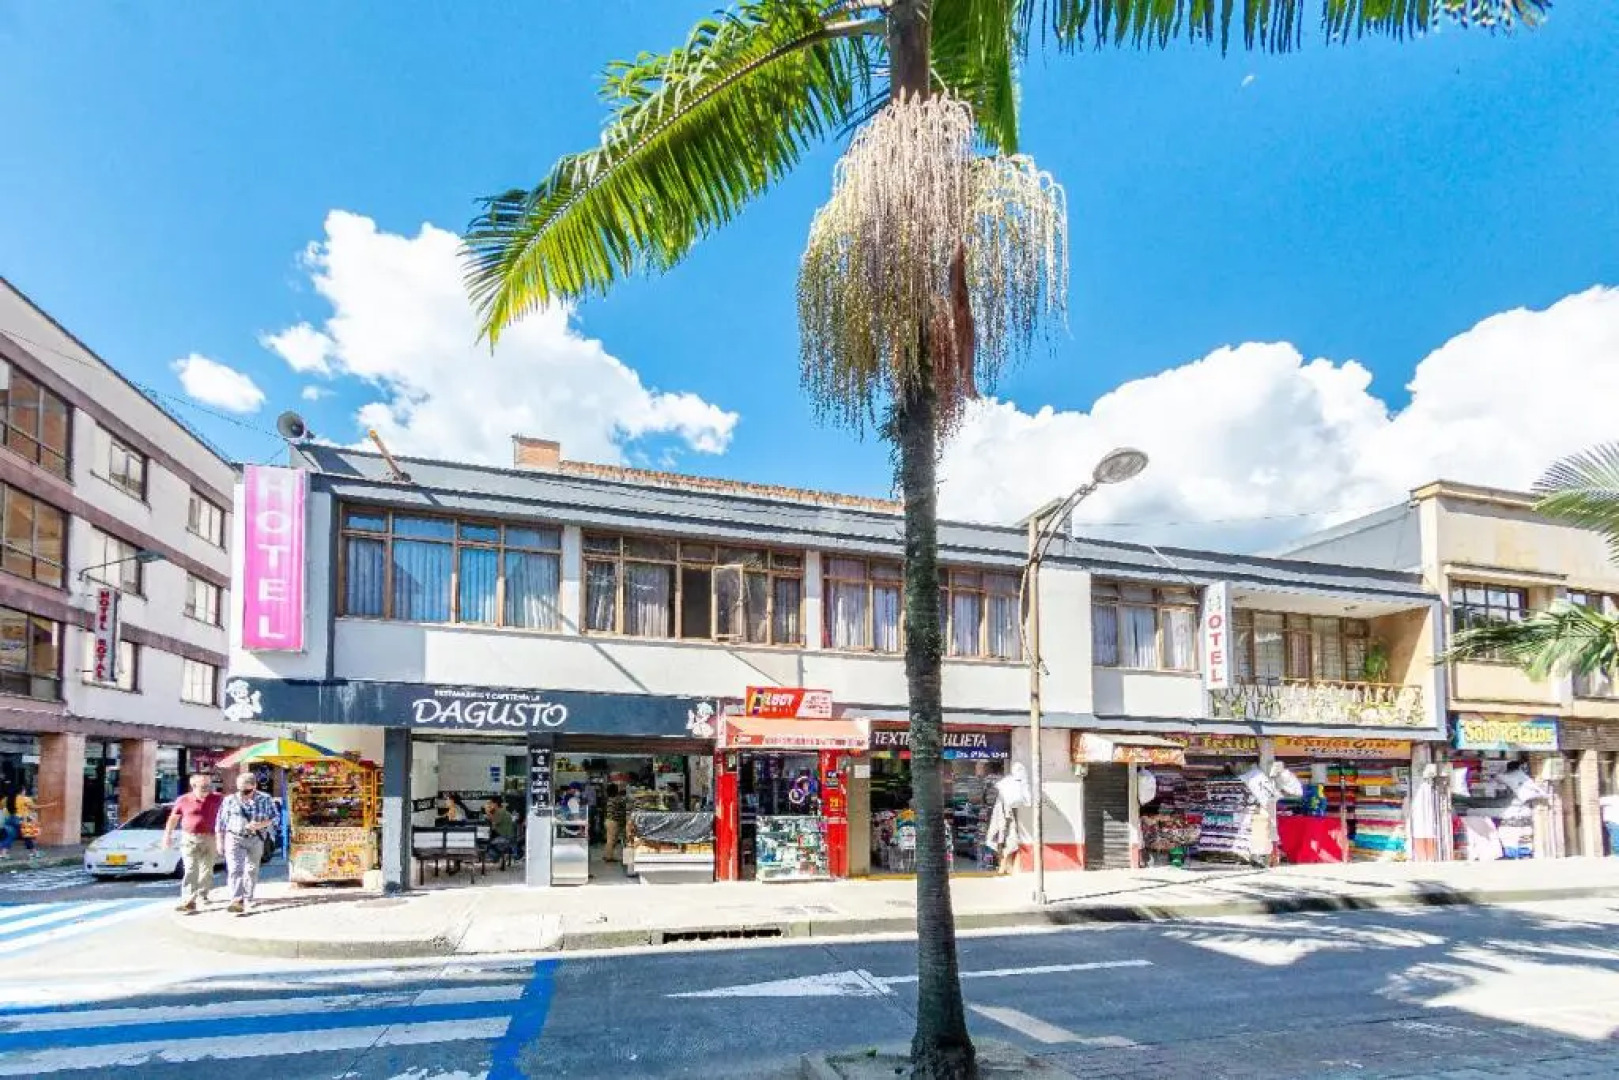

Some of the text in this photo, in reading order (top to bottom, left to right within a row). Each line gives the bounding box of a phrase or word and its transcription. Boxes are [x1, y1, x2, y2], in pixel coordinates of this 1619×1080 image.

[256, 470, 292, 639] HOTEL
[100, 590, 110, 631] HOTEL
[1208, 593, 1223, 683] HOTEL
[412, 699, 567, 727] DAGUSTO
[943, 732, 987, 748] ULIETA
